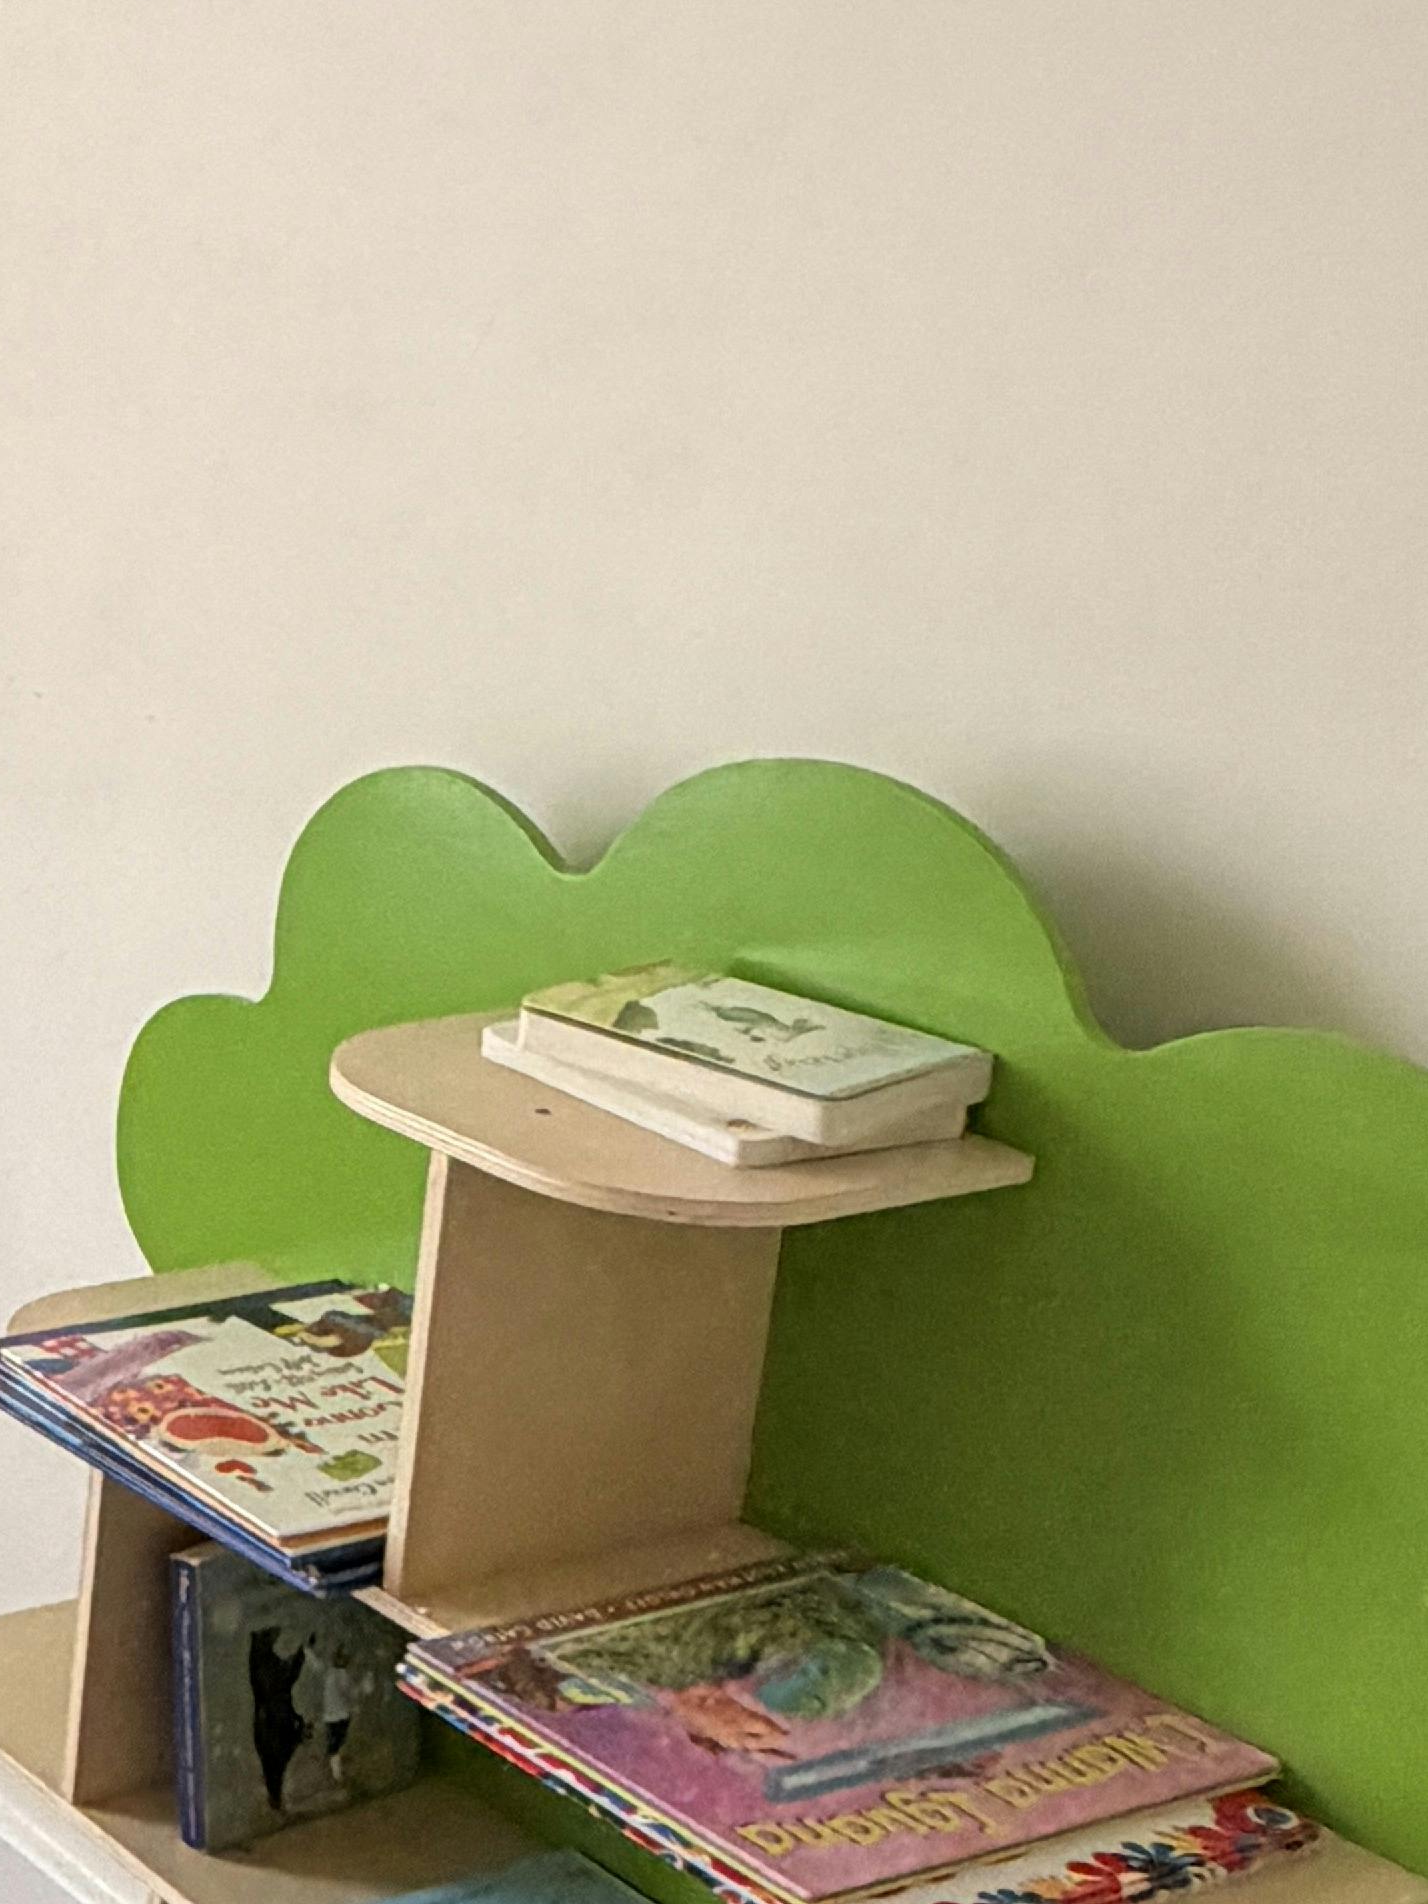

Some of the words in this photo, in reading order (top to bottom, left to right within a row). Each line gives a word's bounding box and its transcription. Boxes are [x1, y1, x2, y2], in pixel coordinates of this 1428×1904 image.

[250, 1390, 318, 1411] Me
[999, 1730, 1169, 1807] Wanna
[741, 1769, 996, 1857] Iguana
